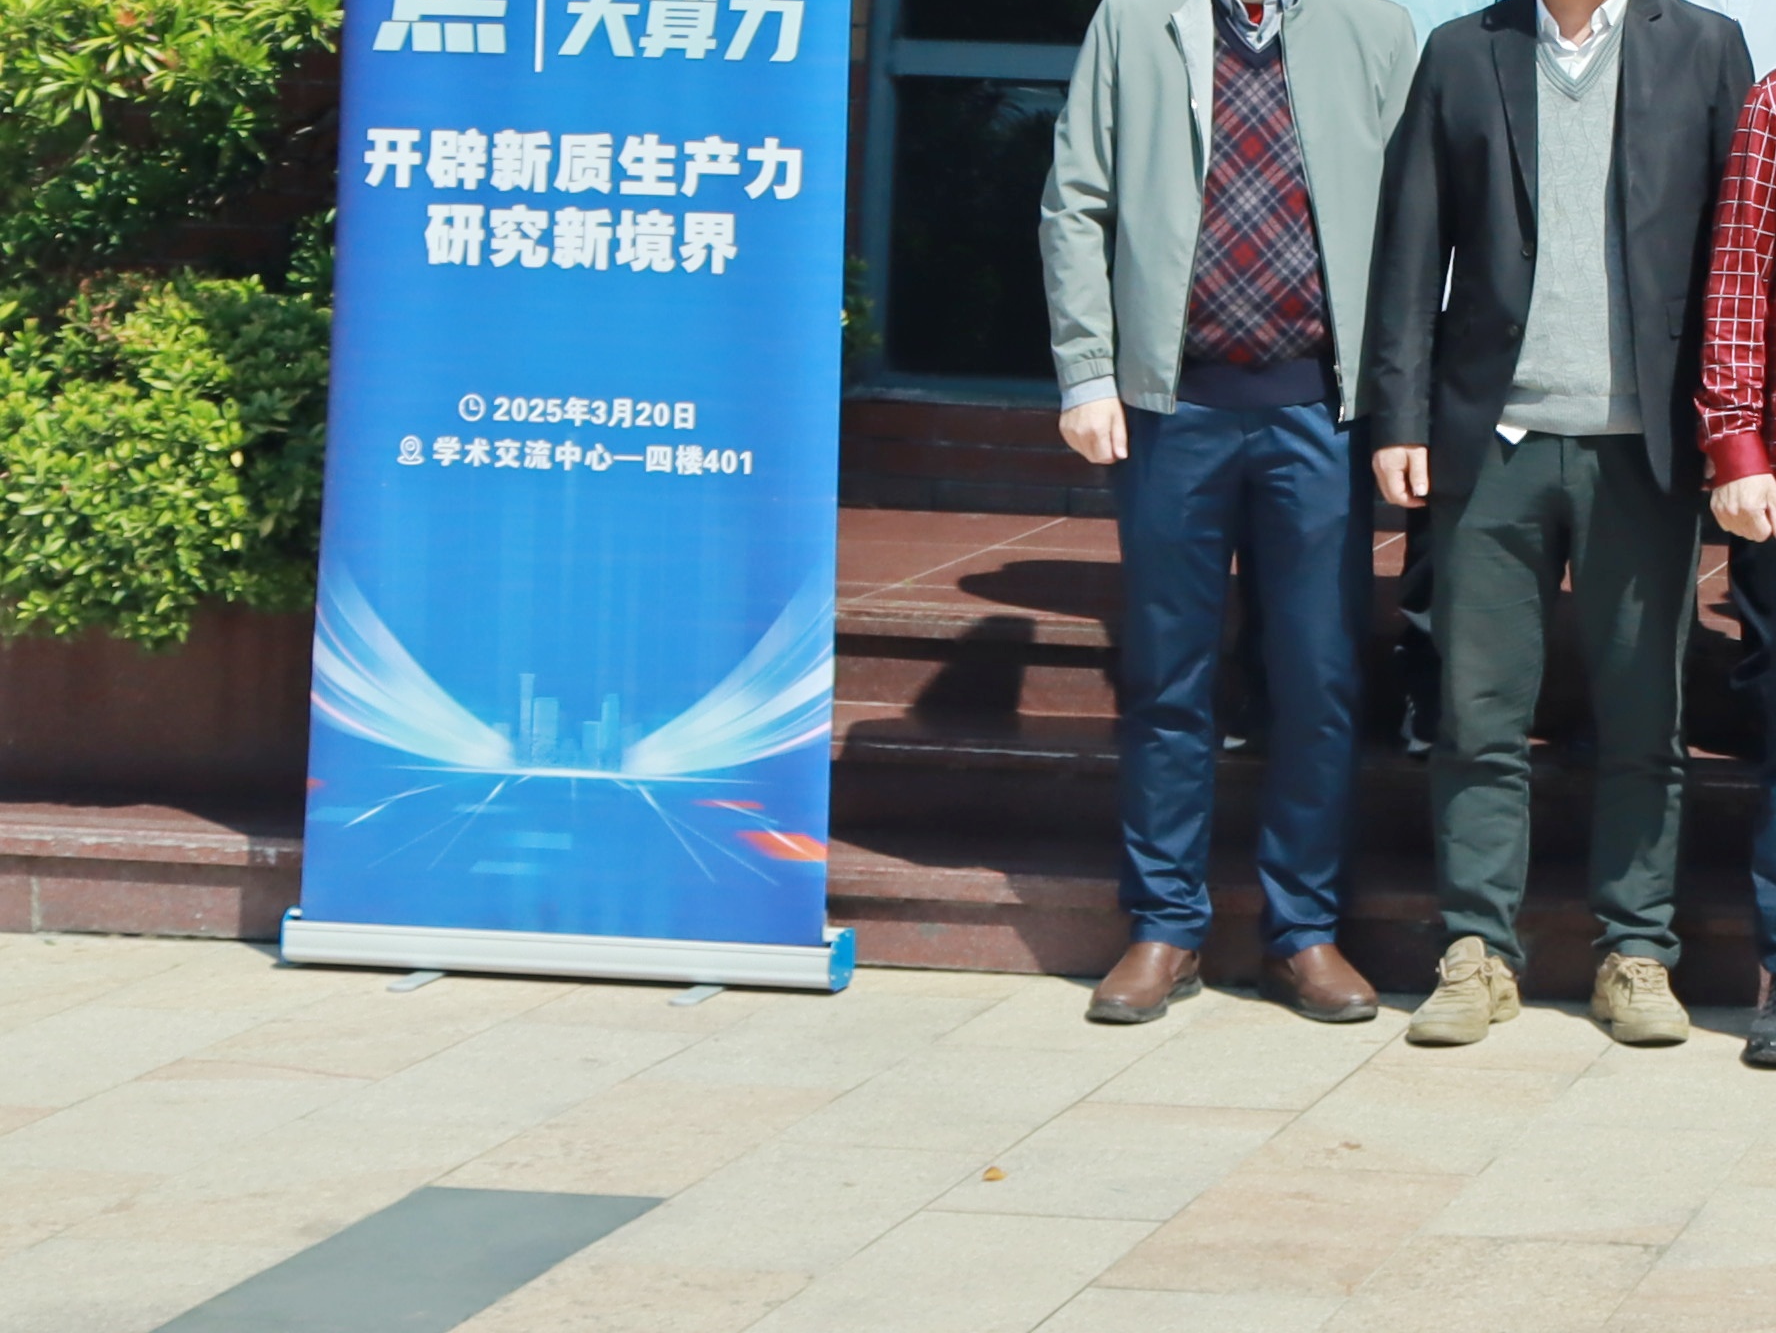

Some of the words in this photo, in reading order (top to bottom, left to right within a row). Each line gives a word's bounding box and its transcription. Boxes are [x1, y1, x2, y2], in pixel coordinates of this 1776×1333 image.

[363, 128, 803, 201] 开辟新质生产力
[424, 204, 738, 275] 研究新境界
[492, 396, 697, 431] 2025年3月20日
